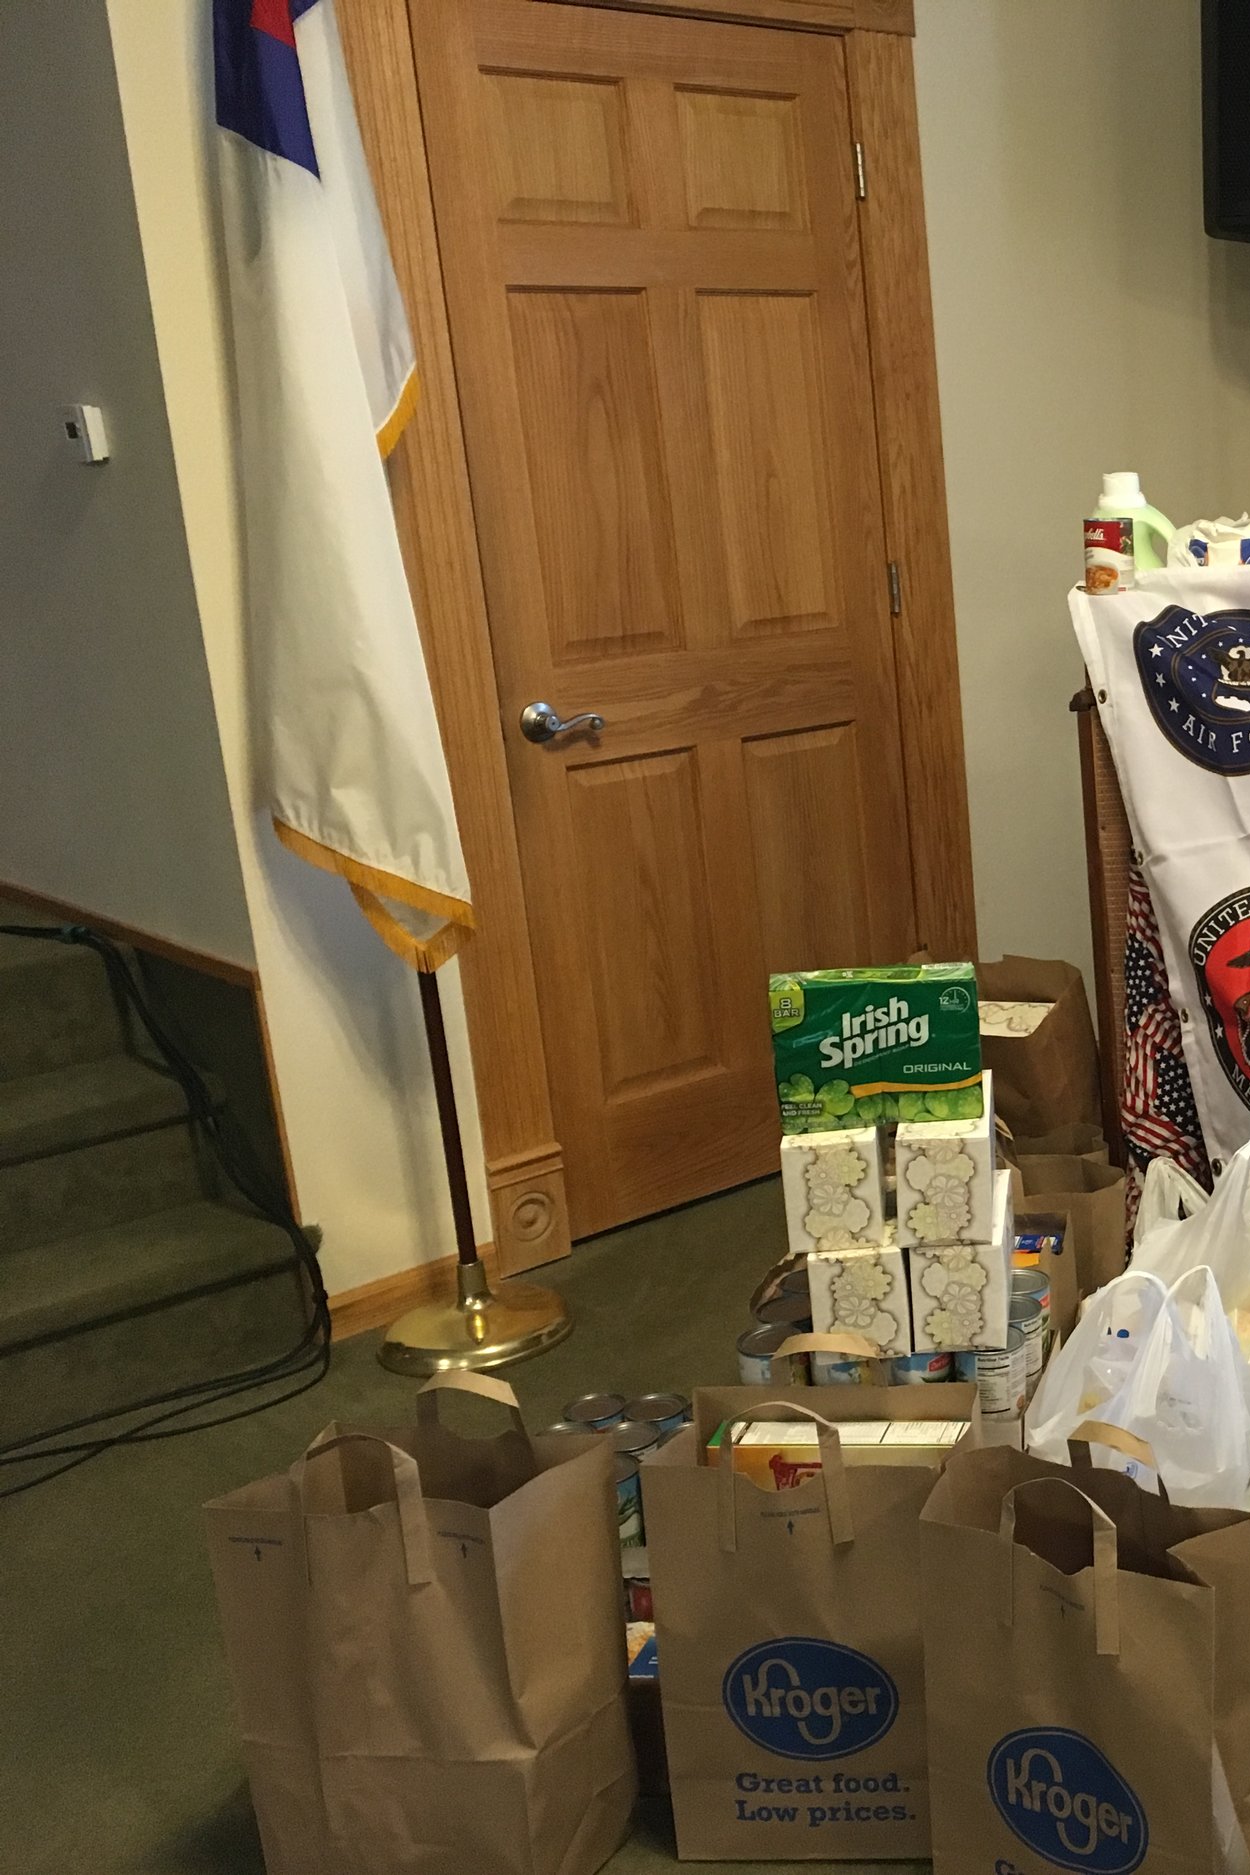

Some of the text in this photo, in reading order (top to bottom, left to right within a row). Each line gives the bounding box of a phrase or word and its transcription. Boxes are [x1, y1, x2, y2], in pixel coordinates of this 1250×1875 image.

[1182, 714, 1218, 752] AIR
[774, 1009, 799, 1018] BAR
[780, 998, 791, 1009] 8
[842, 996, 909, 1039] Irish
[819, 1014, 929, 1069] Spring
[903, 1061, 972, 1074] ORIGINAL
[743, 1658, 880, 1745] Kroger
[736, 1772, 911, 1793] Great food.
[736, 1800, 917, 1827] Low prices.
[1006, 1747, 1132, 1856] Kroger
